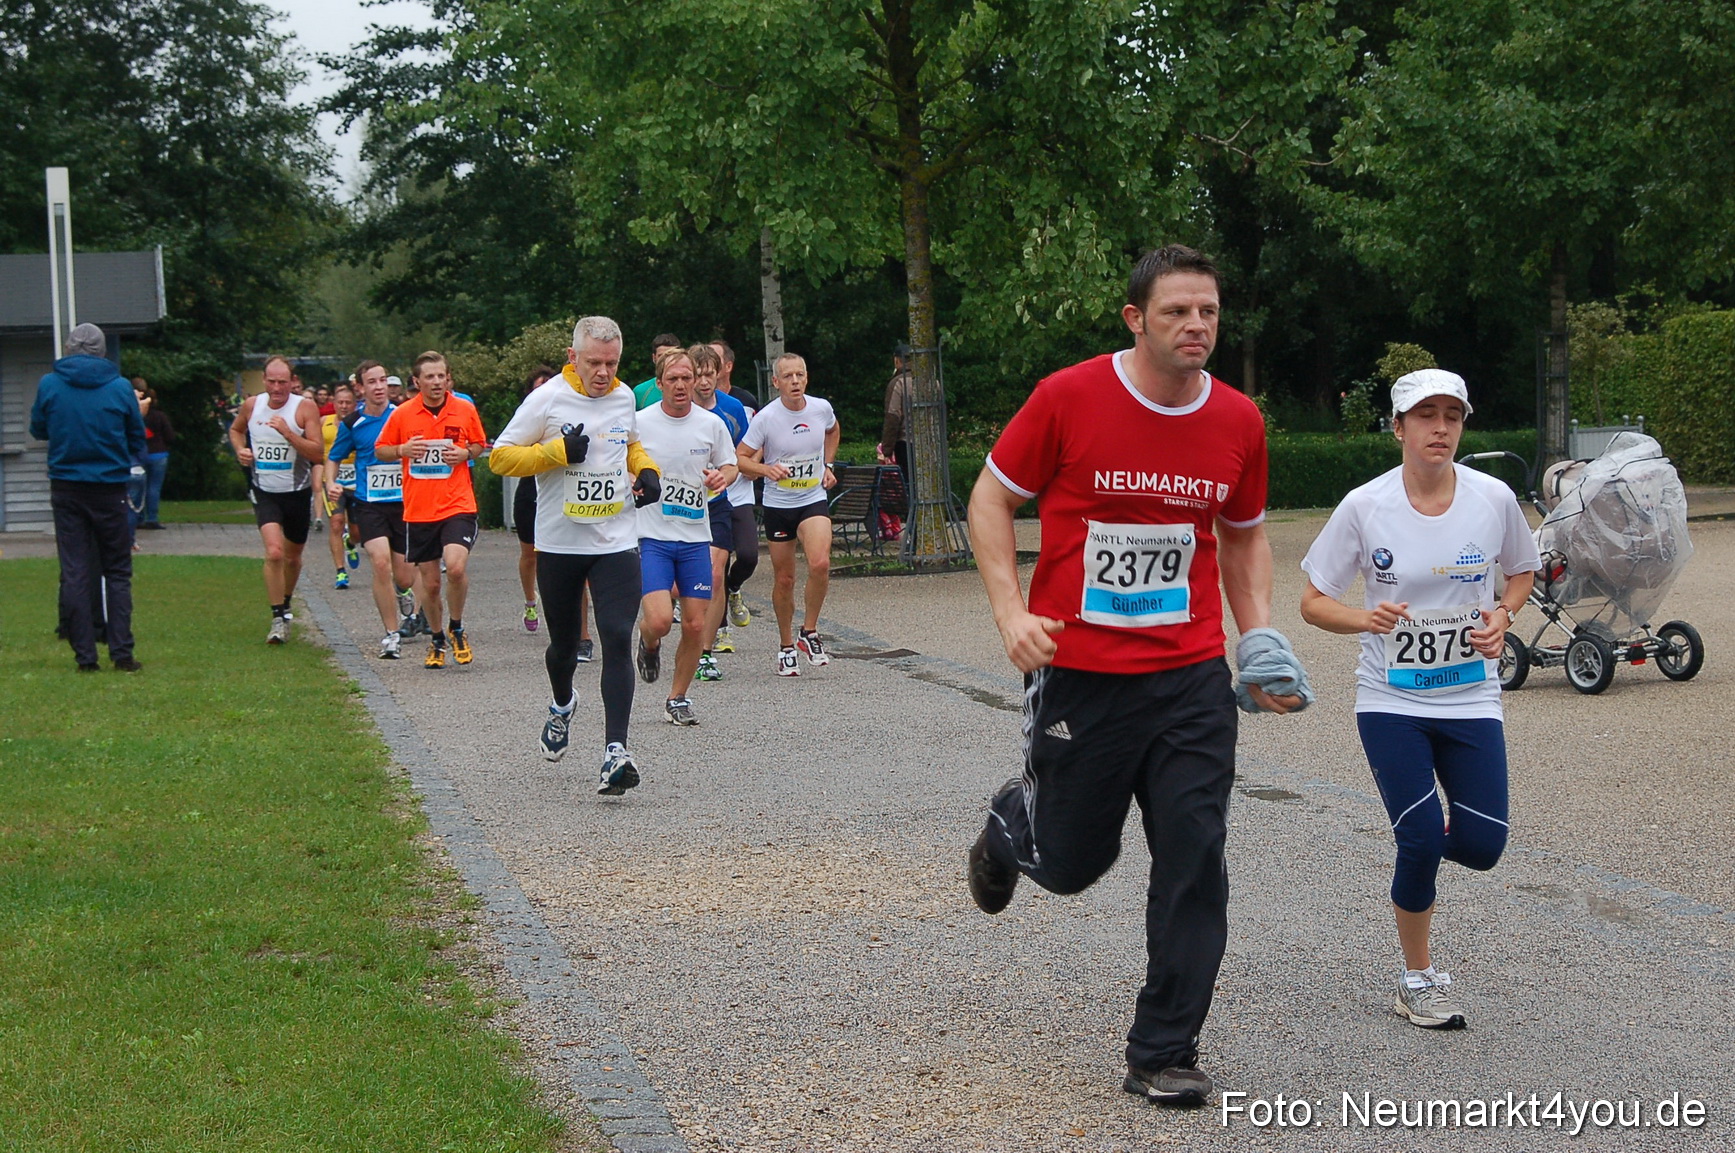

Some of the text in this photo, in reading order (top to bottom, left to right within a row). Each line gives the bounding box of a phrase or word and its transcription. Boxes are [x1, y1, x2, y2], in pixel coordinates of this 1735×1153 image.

[257, 446, 289, 460] 2697
[371, 473, 403, 488] 2716
[565, 470, 586, 478] PARTL
[576, 479, 615, 502] 526
[1094, 470, 1214, 499] NEUMARKT
[664, 485, 704, 508] 2438
[1163, 497, 1189, 507] STARKE
[569, 503, 615, 516] LOTHAR
[671, 506, 692, 517] Stefan
[1126, 535, 1177, 546] Neumarkt
[1096, 548, 1182, 588] 2379
[1111, 596, 1163, 613] Günther
[1421, 614, 1468, 627] Neumarkt
[1395, 625, 1476, 664] 2879
[1414, 670, 1460, 687] Carolin
